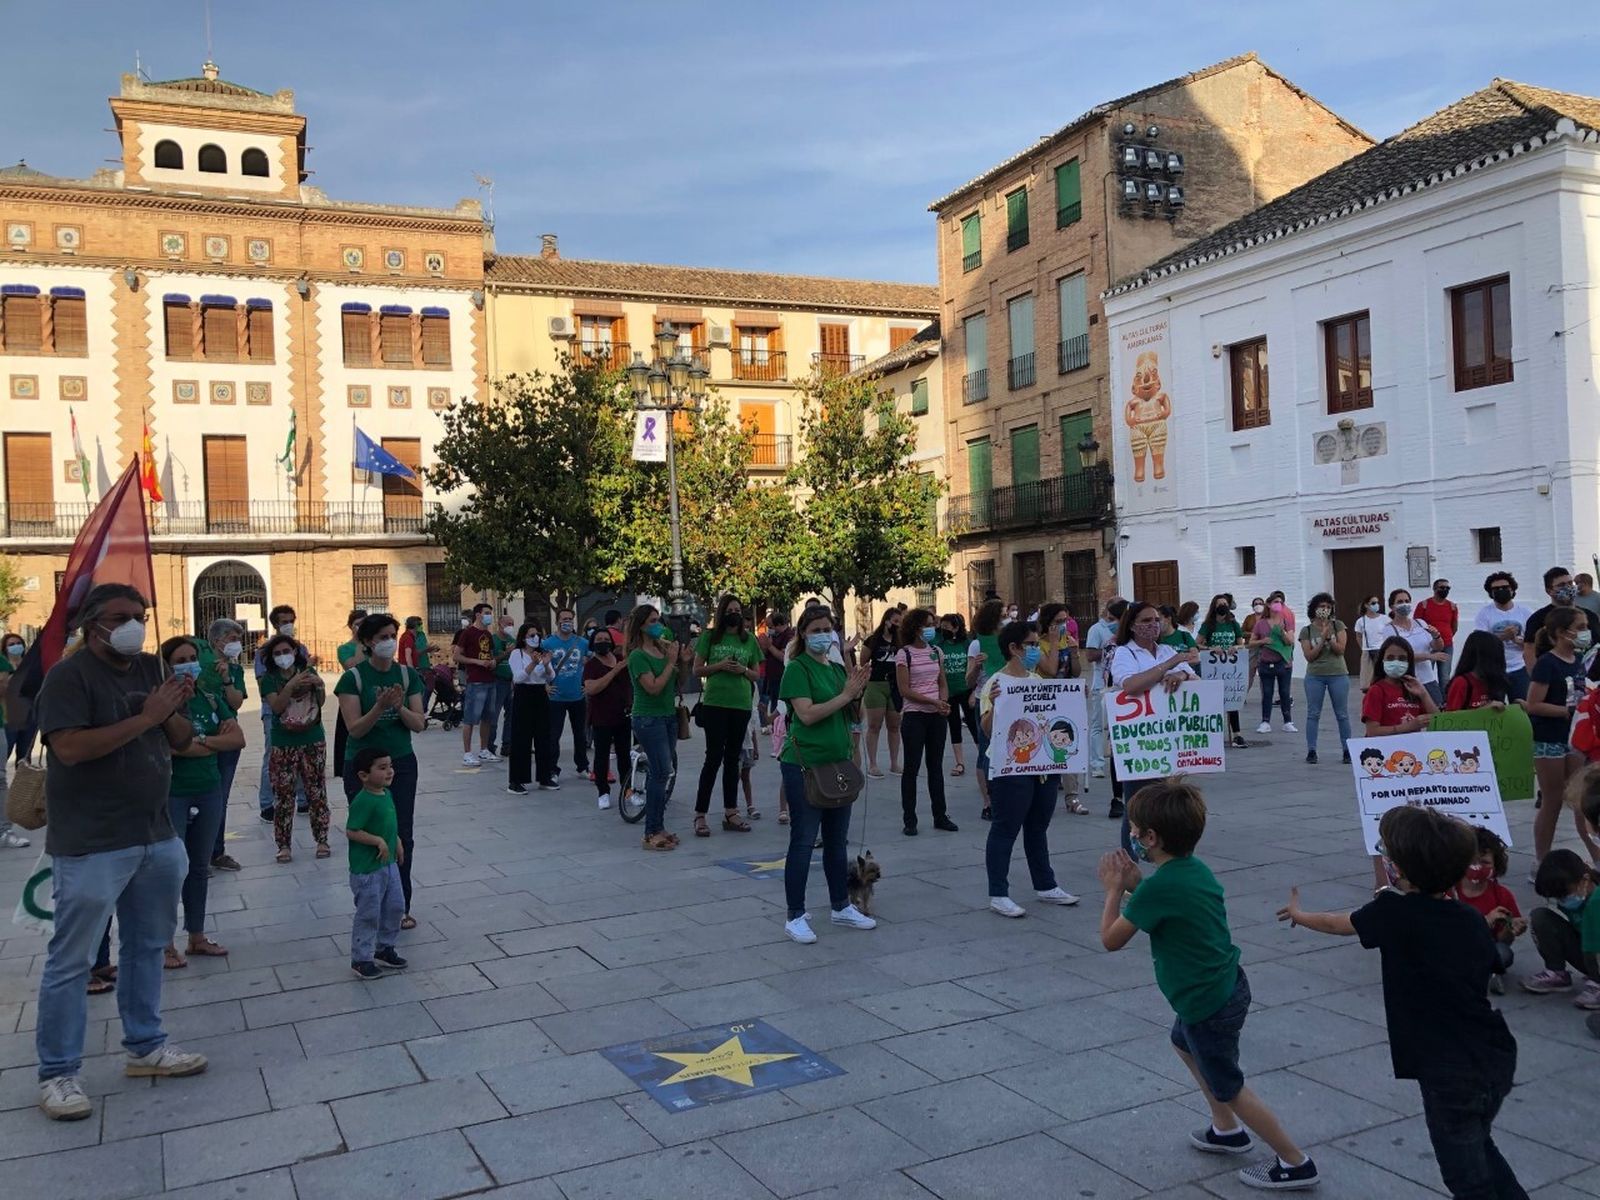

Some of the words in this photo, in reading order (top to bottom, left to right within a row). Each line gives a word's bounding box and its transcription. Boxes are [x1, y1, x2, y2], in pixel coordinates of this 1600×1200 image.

[1313, 517, 1341, 528] ALTAS
[1322, 524, 1381, 537] AMERICANAS
[1209, 651, 1239, 664] SOS
[1007, 685, 1030, 694] LUCHA
[1070, 684, 1081, 692] LA
[1023, 693, 1057, 702] ESCUELA
[1168, 693, 1177, 713] A
[1181, 691, 1200, 712] LA
[1023, 703, 1057, 713] PÚBLICA
[1116, 743, 1130, 754] DE
[1137, 737, 1172, 752] TODOS
[1174, 737, 1180, 750] Y
[1183, 733, 1209, 749] PARA
[1123, 756, 1172, 774] TODOS
[1371, 791, 1390, 799] POR
[1391, 789, 1406, 798] UN
[1407, 785, 1447, 796] REPARTO
[1448, 785, 1491, 794] EQUITATIVO
[1423, 796, 1470, 805] ALUMNADO
